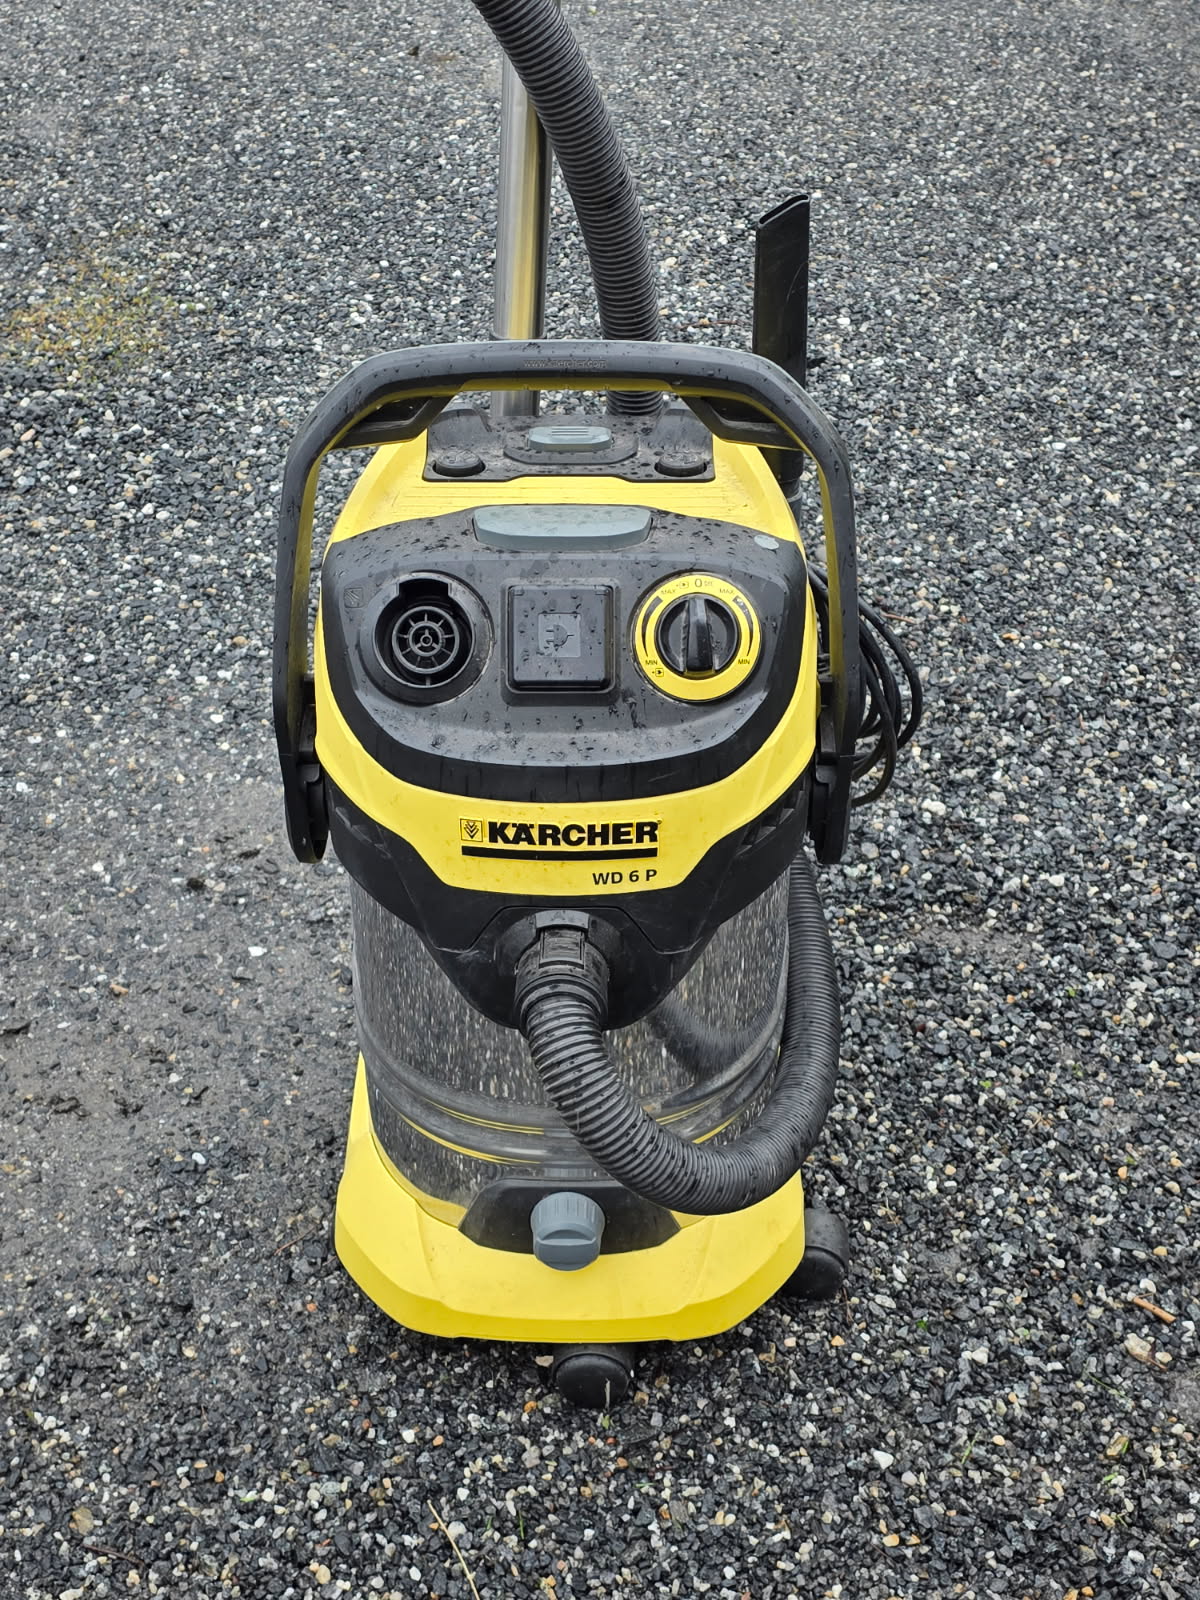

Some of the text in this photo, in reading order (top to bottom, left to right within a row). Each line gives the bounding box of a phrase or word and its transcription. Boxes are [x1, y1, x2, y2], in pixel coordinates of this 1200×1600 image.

[488, 821, 659, 846] KÄRCHER
[592, 869, 657, 885] WD 6 P
